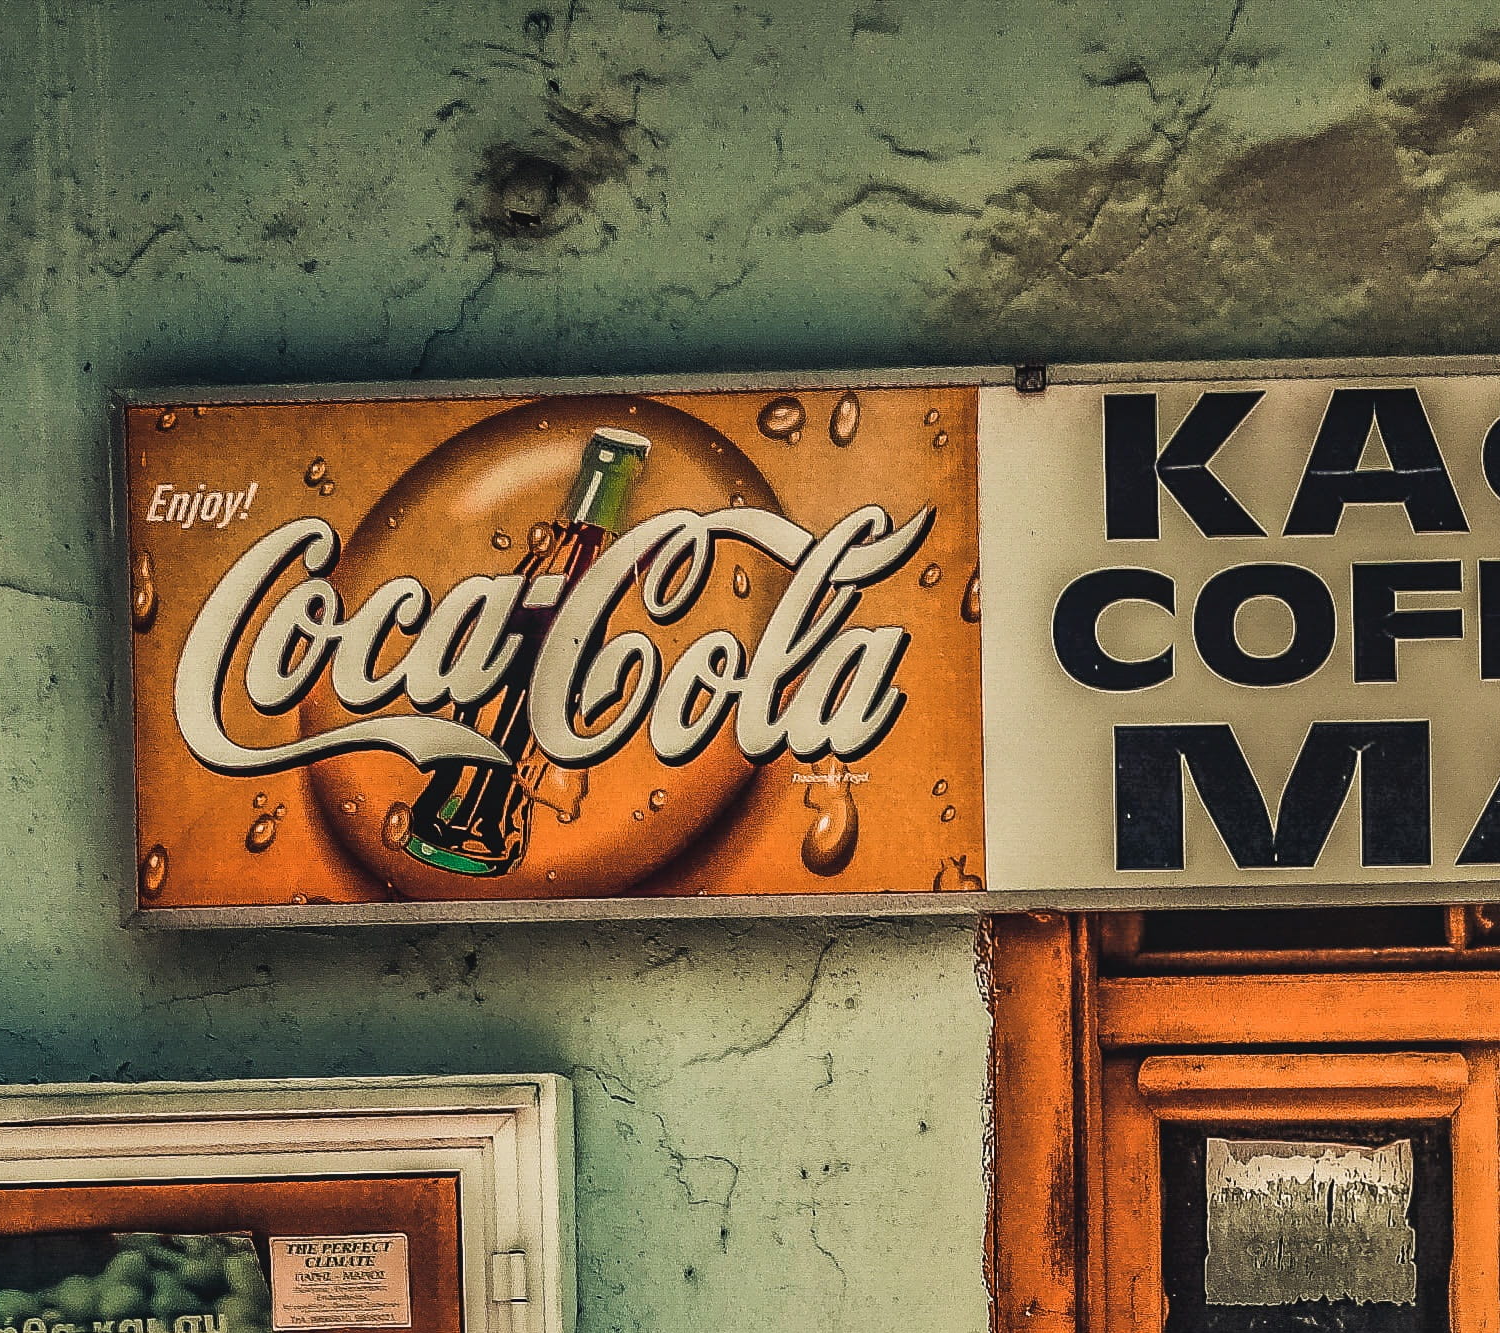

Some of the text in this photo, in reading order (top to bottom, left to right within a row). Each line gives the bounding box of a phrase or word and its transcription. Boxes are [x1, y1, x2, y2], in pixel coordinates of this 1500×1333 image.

[146, 481, 254, 528] Enjoy!
[174, 505, 936, 773] Coca-Cola
[286, 1241, 392, 1255] THE PERFECT
[304, 1255, 376, 1268] CLIMATE
